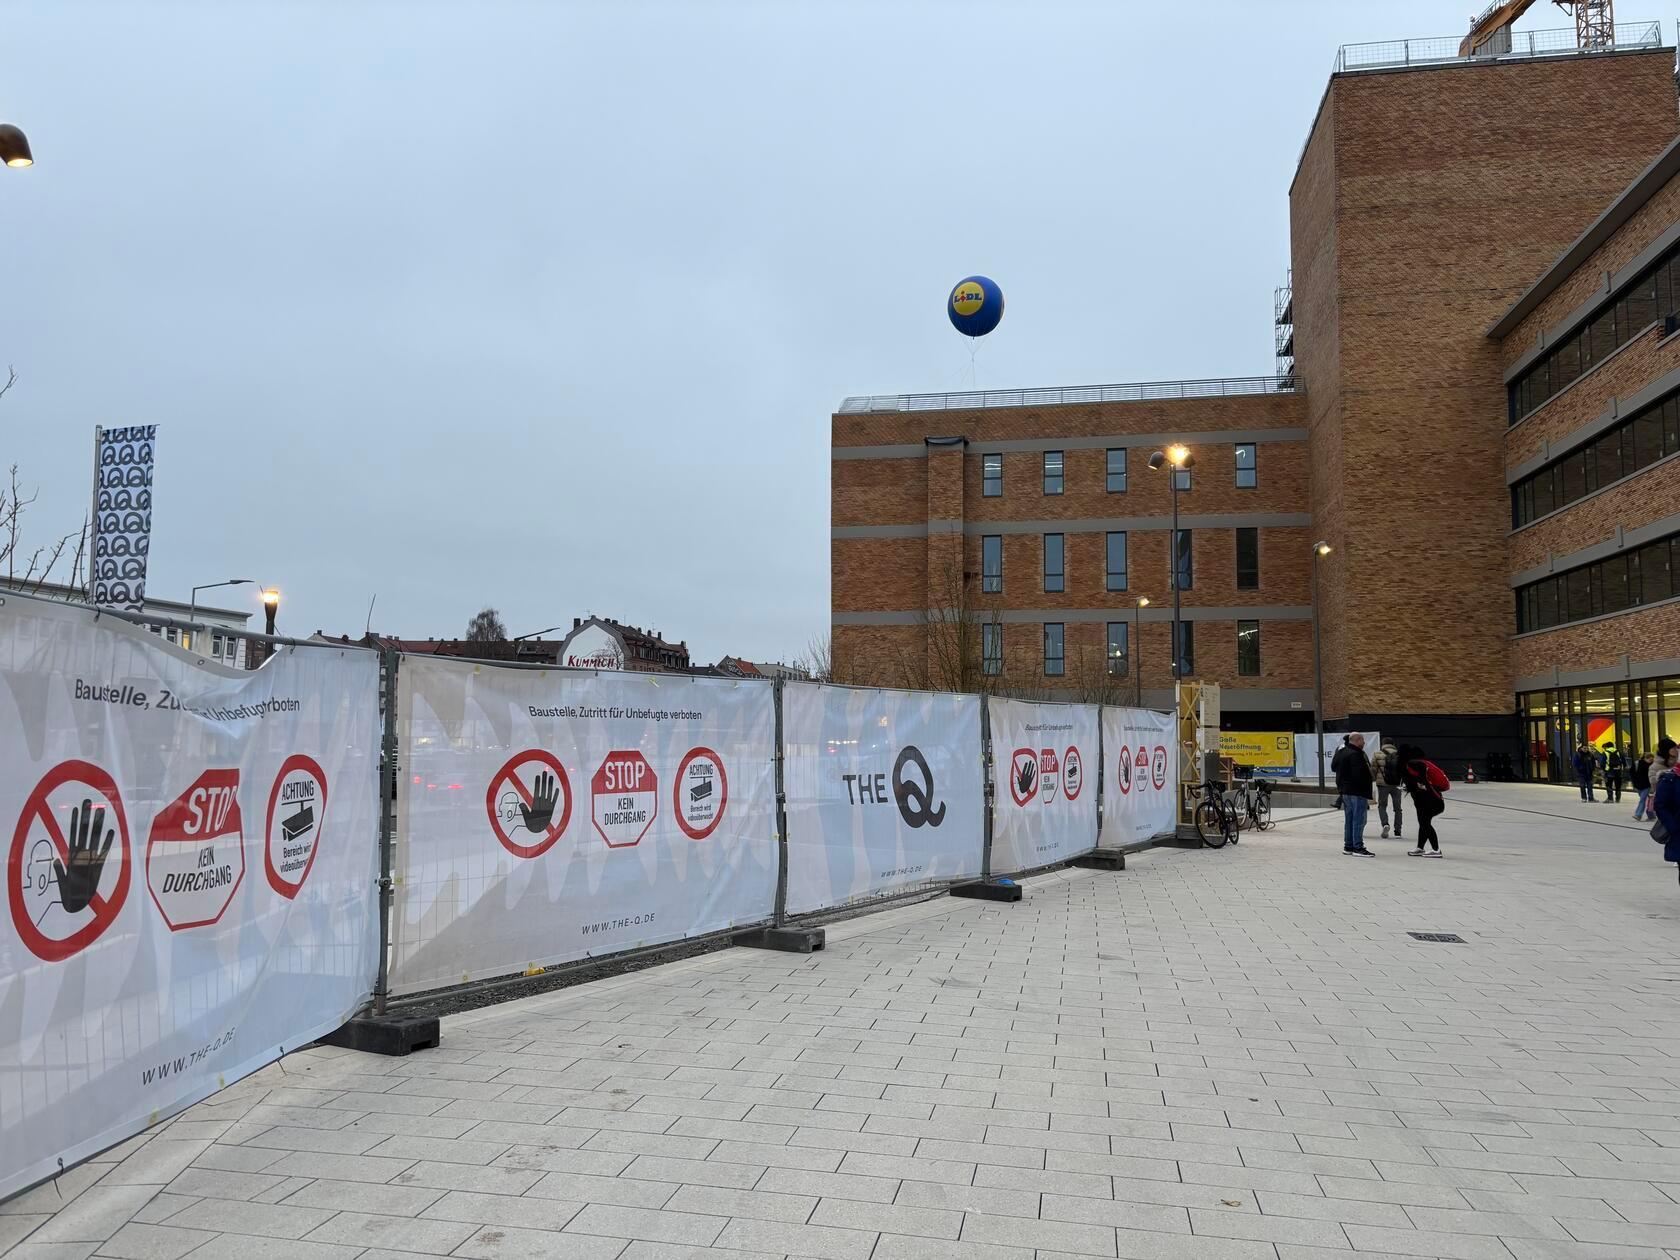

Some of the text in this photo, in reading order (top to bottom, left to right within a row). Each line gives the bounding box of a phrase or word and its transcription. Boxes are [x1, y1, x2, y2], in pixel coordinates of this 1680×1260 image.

[75, 678, 149, 710] Baustelle,
[528, 705, 702, 722] Baustelle, Zutritt für Unbefugte verboten
[605, 760, 646, 790] STOP
[689, 763, 714, 776] ACHTUNG
[281, 780, 315, 801] ACHTUNG
[842, 745, 947, 829] THE Q
[617, 797, 634, 811] KEIN
[604, 810, 647, 826] DURCHGANG
[197, 845, 215, 869] KEIN
[283, 844, 304, 858] Bereich
[162, 865, 233, 894] DURCHGANG
[582, 912, 656, 935] WWW.THE-Q.DE
